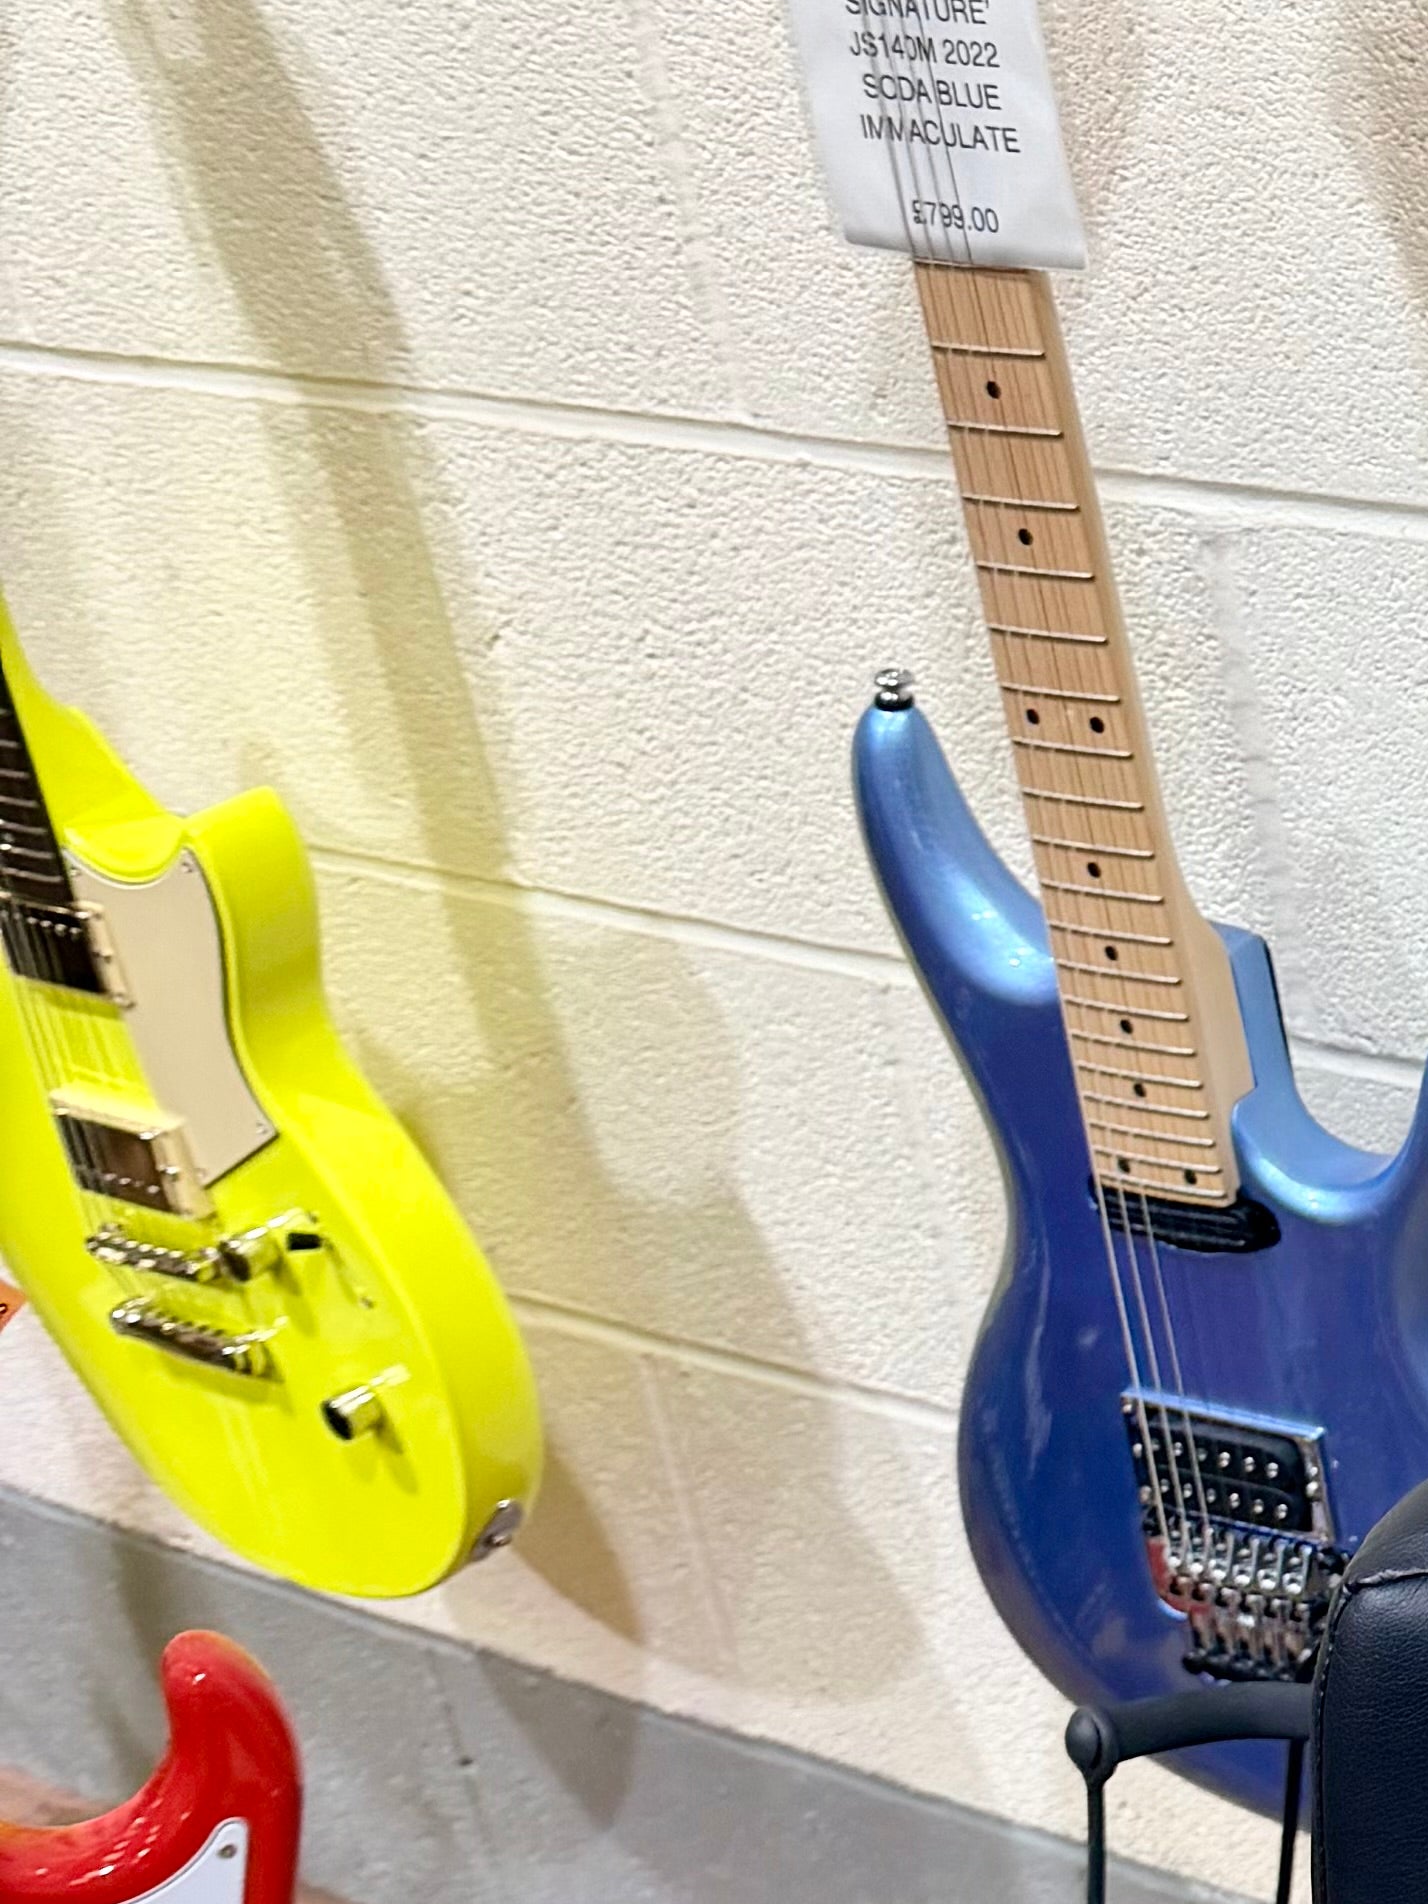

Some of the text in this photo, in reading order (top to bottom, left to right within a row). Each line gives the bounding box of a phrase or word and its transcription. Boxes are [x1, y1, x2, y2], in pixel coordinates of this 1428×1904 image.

[849, 31, 1001, 68] JS140M 2022
[863, 73, 1002, 111] SODA BLUE
[860, 114, 1021, 154] IMMACULATE
[912, 199, 999, 234] £799.00
